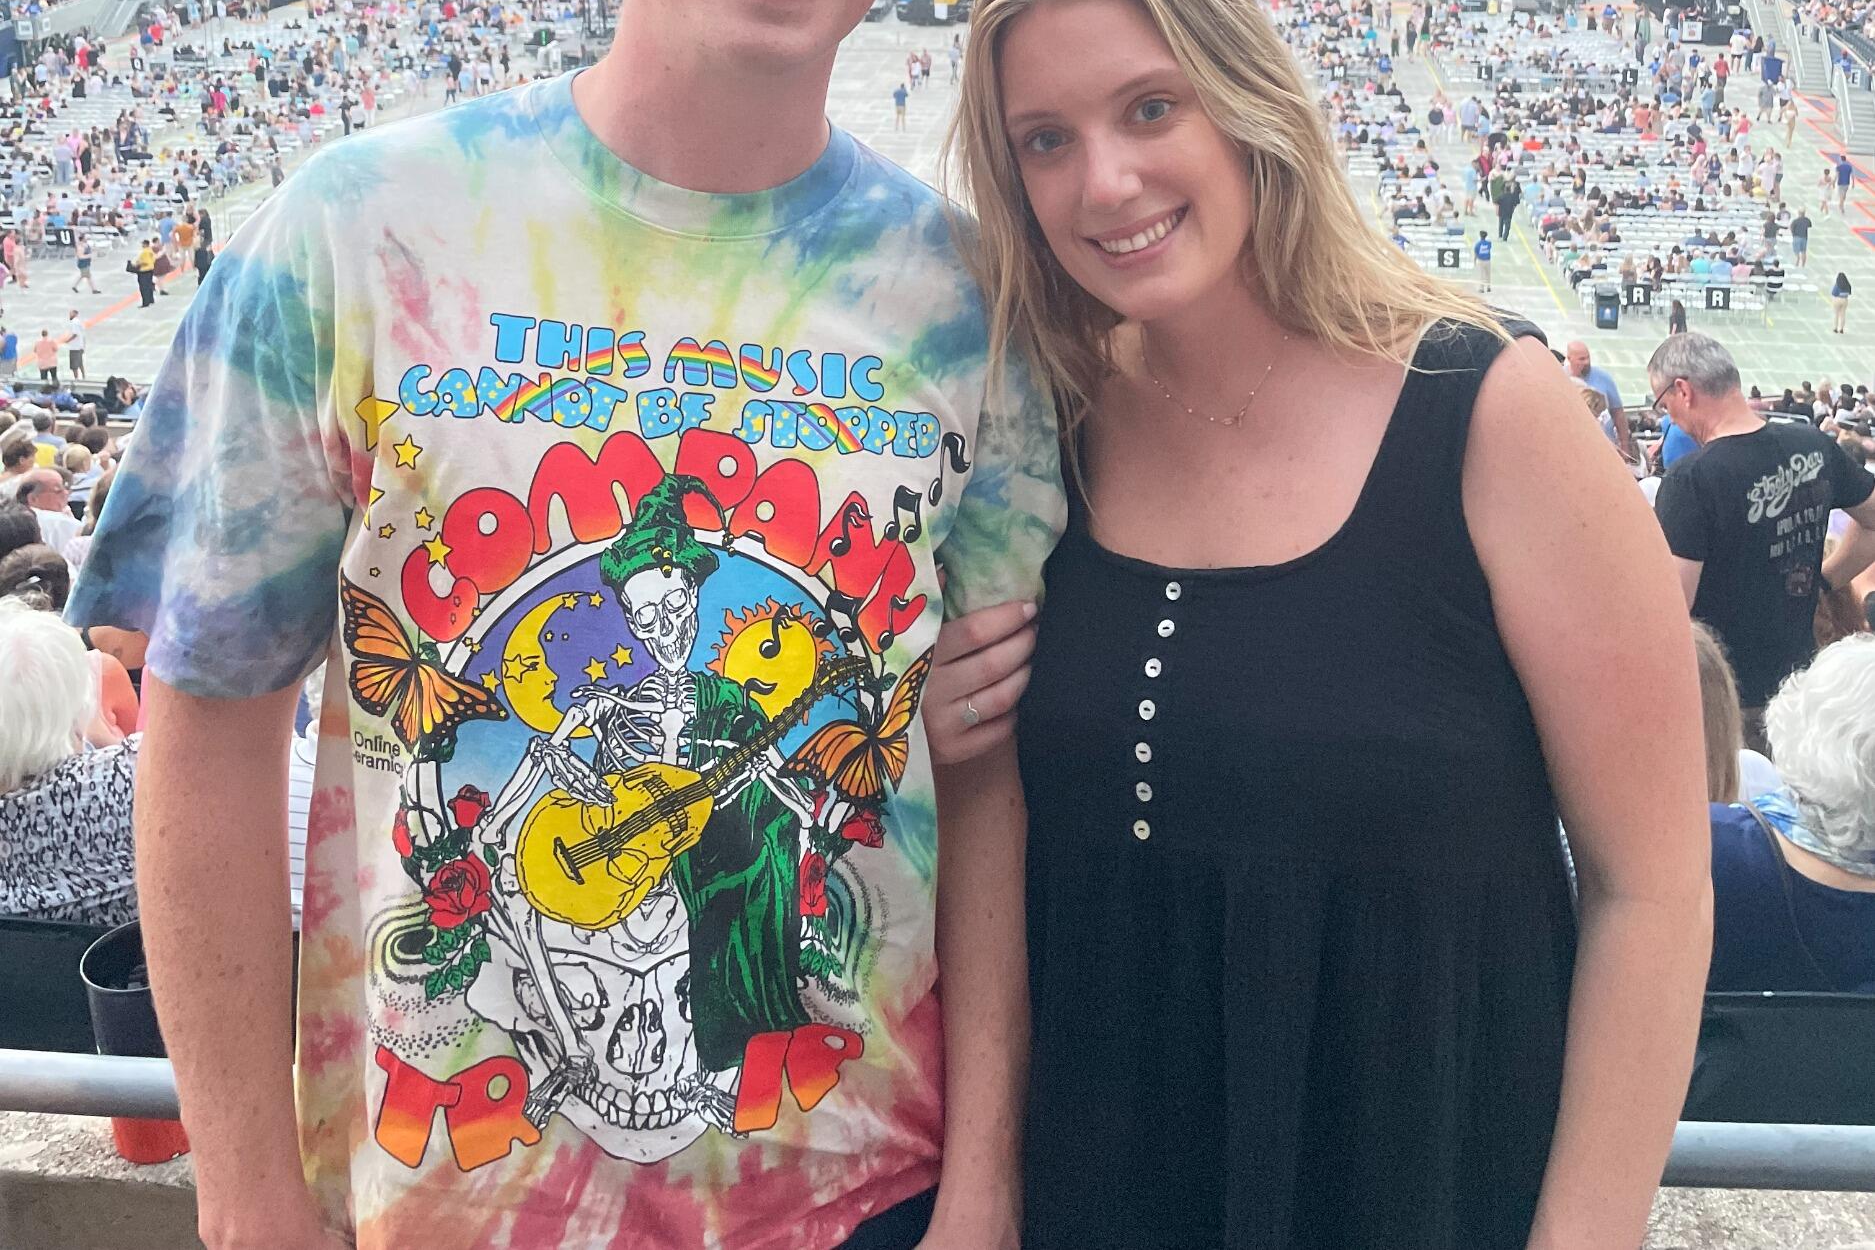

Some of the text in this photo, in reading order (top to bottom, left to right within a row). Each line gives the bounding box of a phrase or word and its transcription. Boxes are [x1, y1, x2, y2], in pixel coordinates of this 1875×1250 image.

[60, 229, 71, 245] U
[1443, 250, 1455, 267] S
[1632, 286, 1645, 304] R
[1711, 290, 1724, 307] R
[490, 313, 884, 402] THIS MUSIC
[398, 364, 941, 459] CANNOT BE STOPPED
[400, 427, 927, 651] COMPANY
[354, 730, 401, 757] Online
